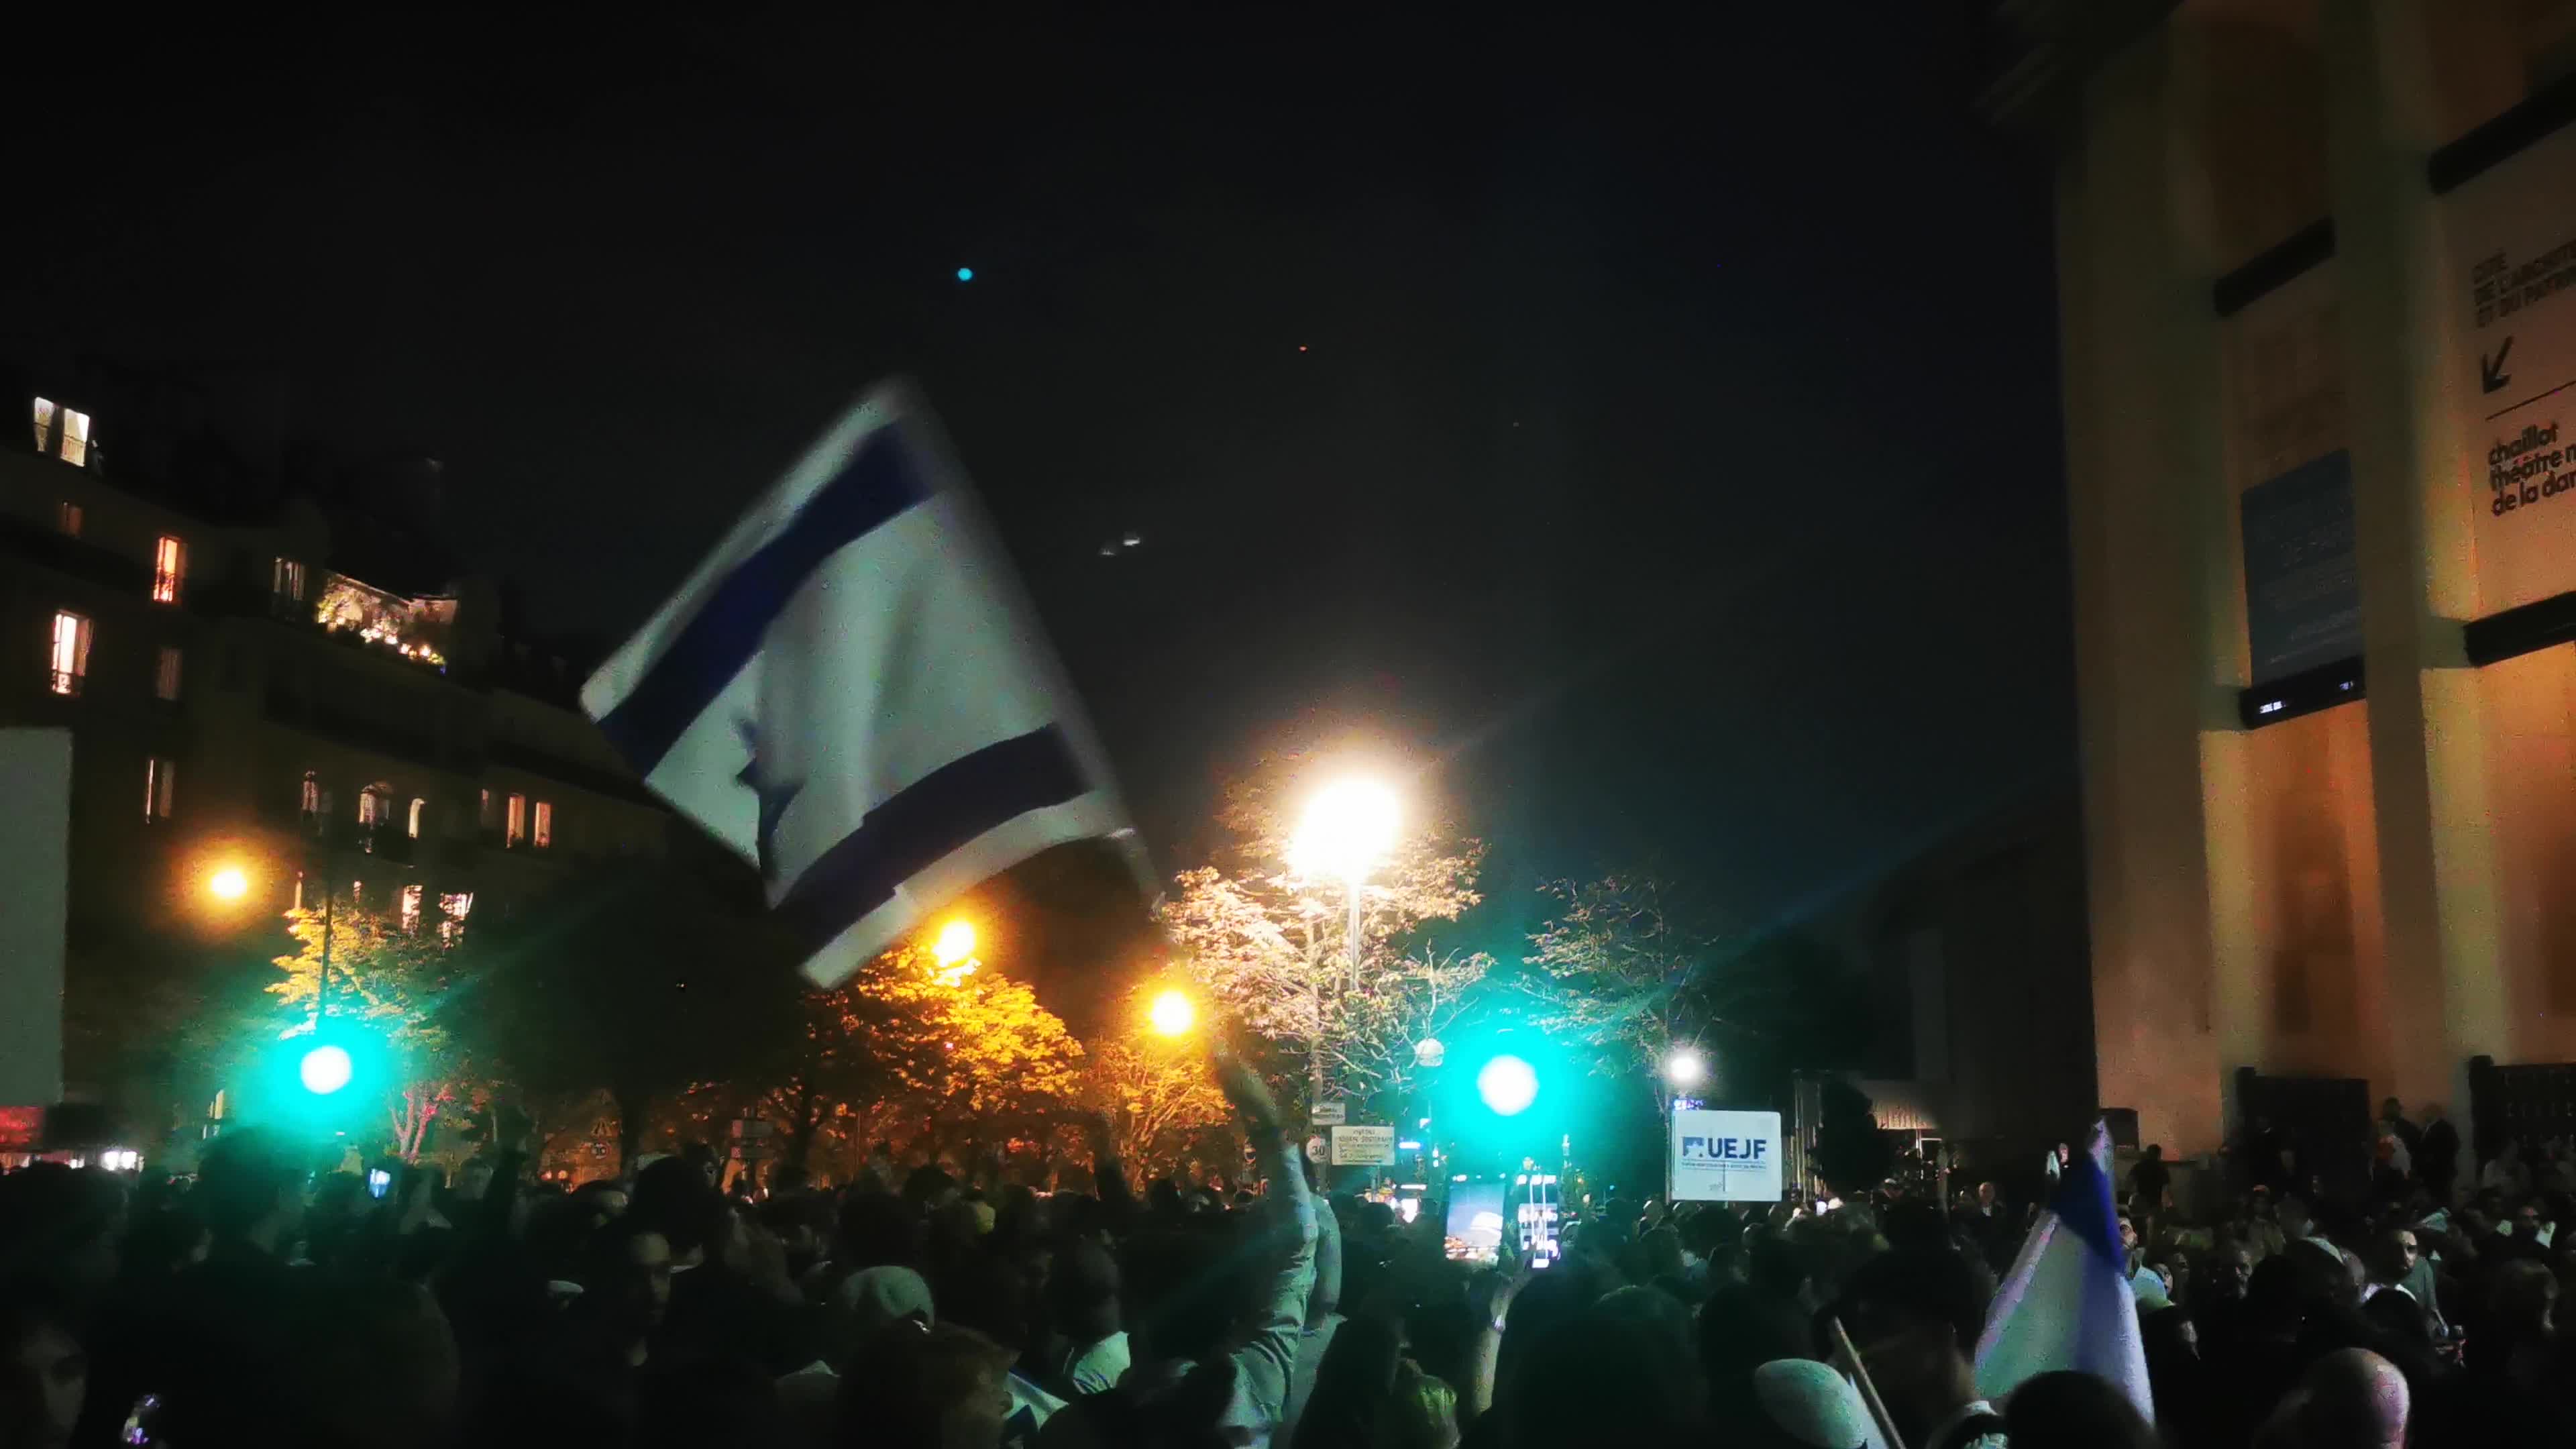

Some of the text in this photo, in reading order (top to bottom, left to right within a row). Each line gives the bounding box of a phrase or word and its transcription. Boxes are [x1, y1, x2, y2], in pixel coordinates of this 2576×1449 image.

[2489, 423, 2558, 465] chaillot
[2492, 490, 2516, 517] de
[2519, 482, 2538, 507] la
[1312, 1146, 1326, 1156] 30
[1707, 1137, 1767, 1160] UEJF
